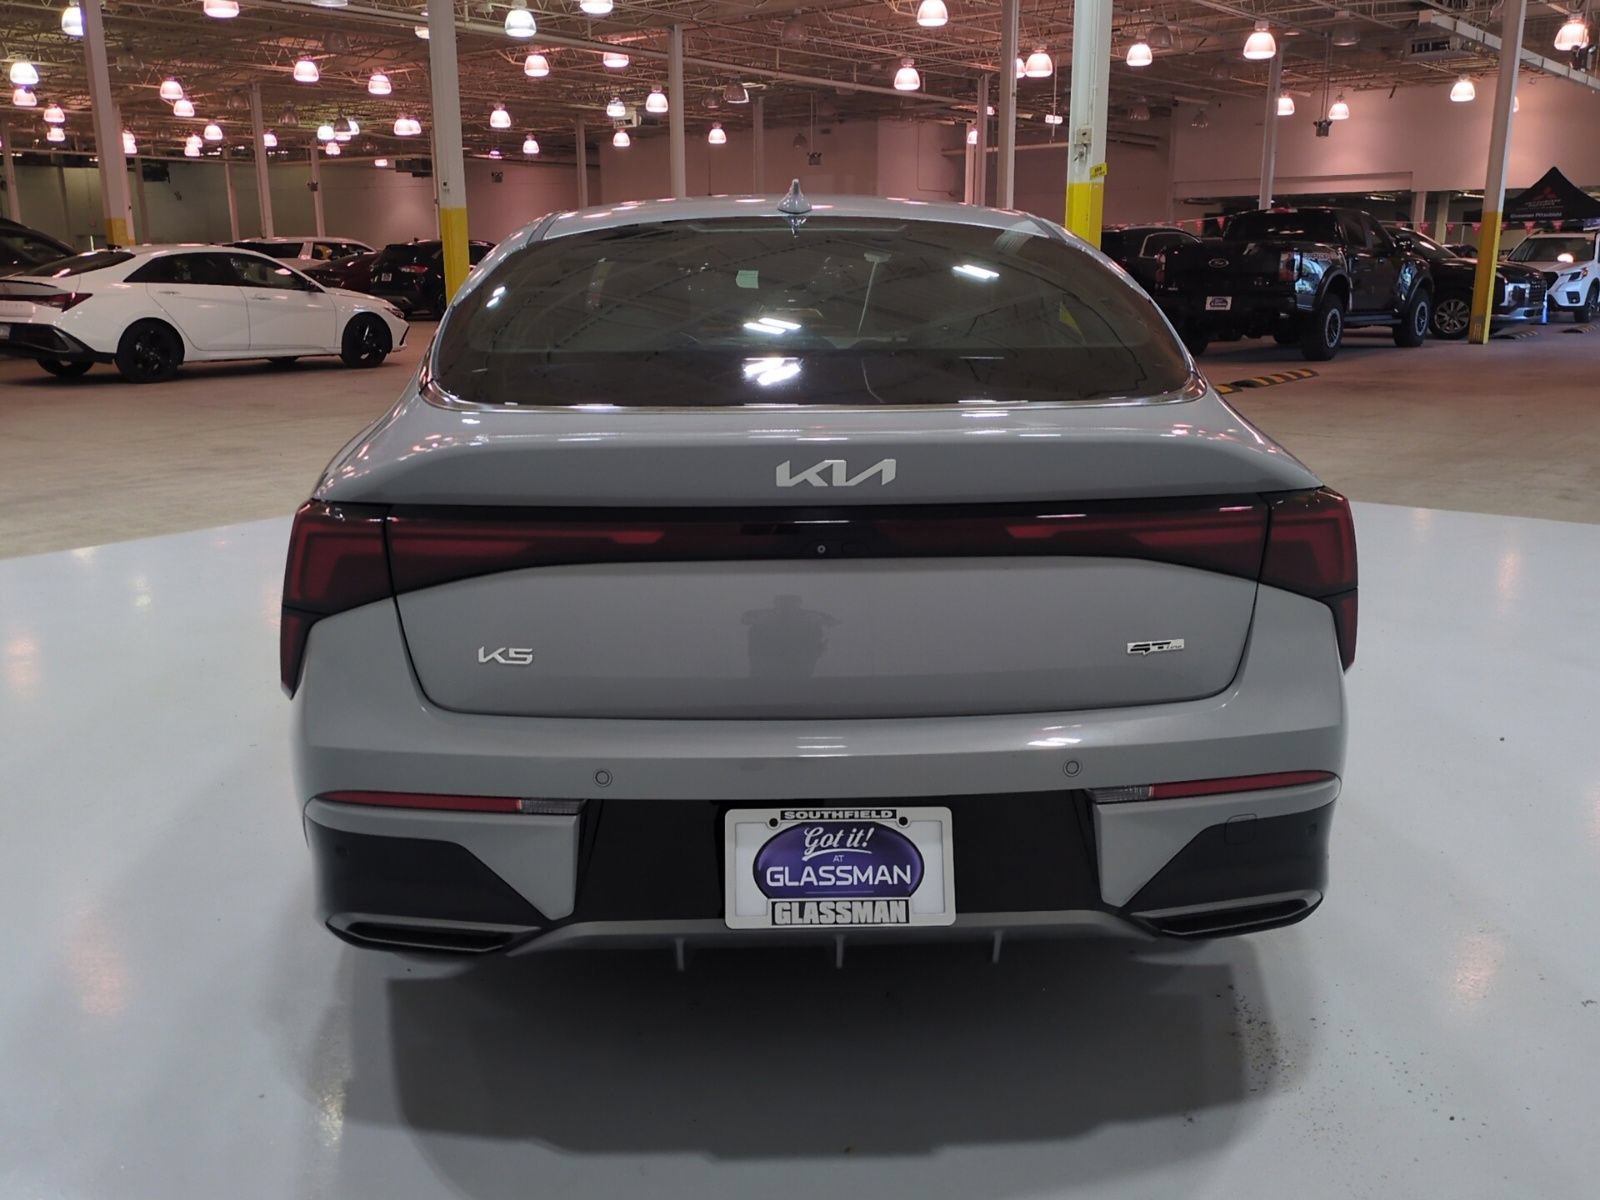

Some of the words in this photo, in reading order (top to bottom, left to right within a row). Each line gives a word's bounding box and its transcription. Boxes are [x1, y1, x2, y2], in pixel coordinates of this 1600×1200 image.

[776, 458, 897, 487] KIA
[478, 646, 533, 665] K5
[784, 810, 893, 820] SOUTHFIELD
[804, 827, 844, 855] Got
[846, 828, 875, 848] it!
[833, 855, 844, 863] AT
[766, 865, 911, 887] GLASSMAN
[774, 901, 907, 925] GLASSMAN
